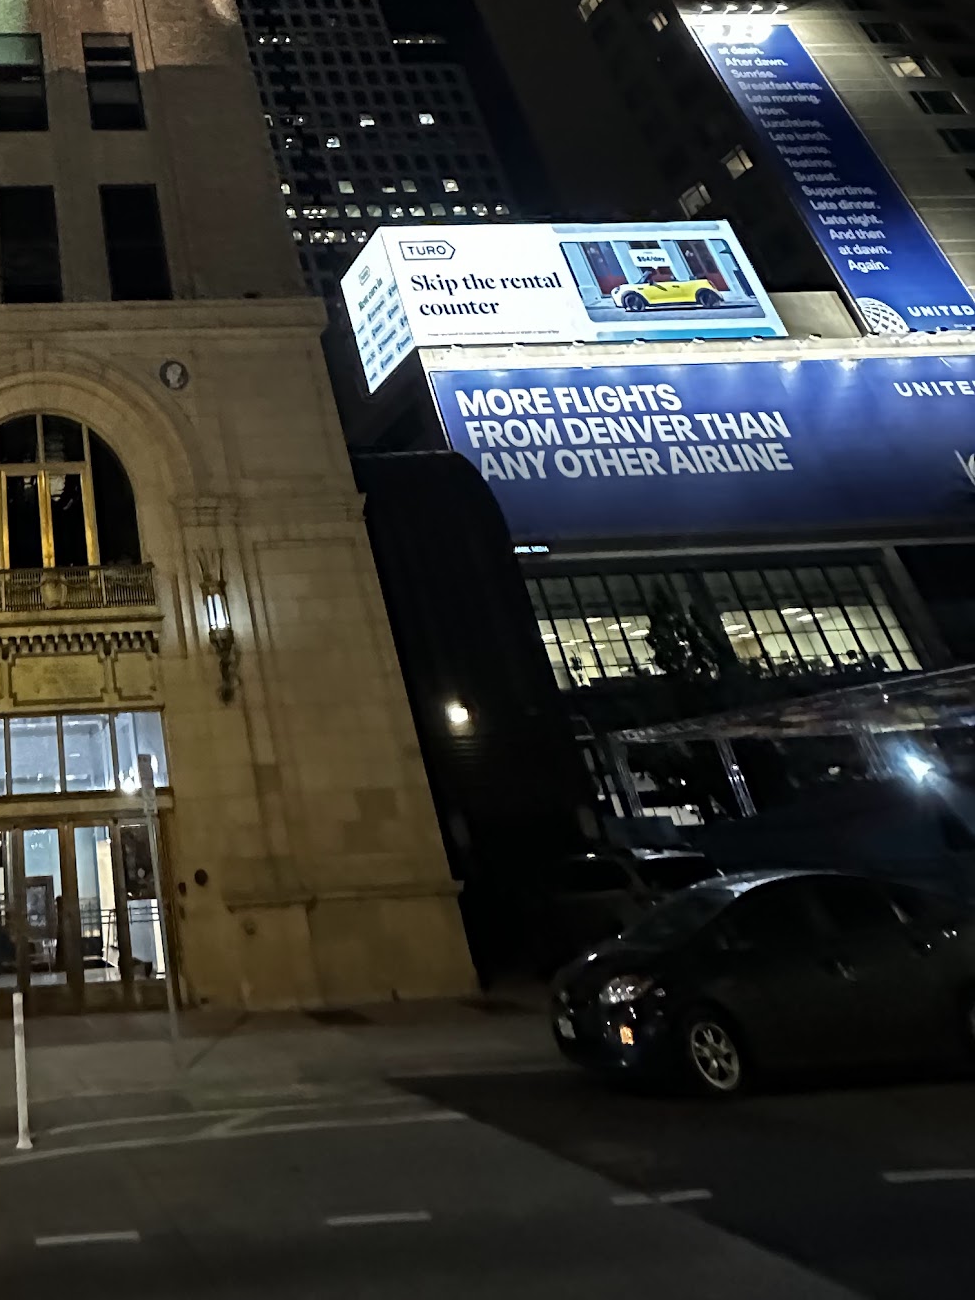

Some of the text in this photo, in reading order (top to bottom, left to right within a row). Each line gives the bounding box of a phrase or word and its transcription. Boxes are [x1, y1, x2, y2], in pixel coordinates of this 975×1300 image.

[725, 58, 788, 66] After dawn.
[731, 70, 777, 78] Sunrise.
[738, 81, 823, 90] Breakfast time.
[745, 94, 821, 105] Late morning.
[753, 106, 789, 115] Noon.
[760, 118, 824, 128] Lunchtime.
[769, 131, 831, 141] Late lunch.
[777, 144, 831, 156] Naptime.
[793, 172, 840, 182] Sunset.
[801, 185, 877, 198] Suppertime.
[809, 200, 881, 210] Late dinner.
[819, 214, 883, 227] Late night.
[829, 229, 885, 240] And then
[406, 245, 447, 256] TURO
[838, 244, 892, 255] at dawn.
[848, 260, 889, 273] Again.
[410, 274, 459, 296] Skip
[461, 274, 497, 290] the
[499, 272, 564, 289] rental
[419, 301, 500, 316] counter
[907, 305, 975, 317] UNITED
[893, 381, 975, 397] UNITE
[454, 383, 683, 418] MORE FLIGHTS
[465, 411, 792, 449] FROM DENVER THAN
[479, 442, 794, 482] ANY OTHER AIRLINE
